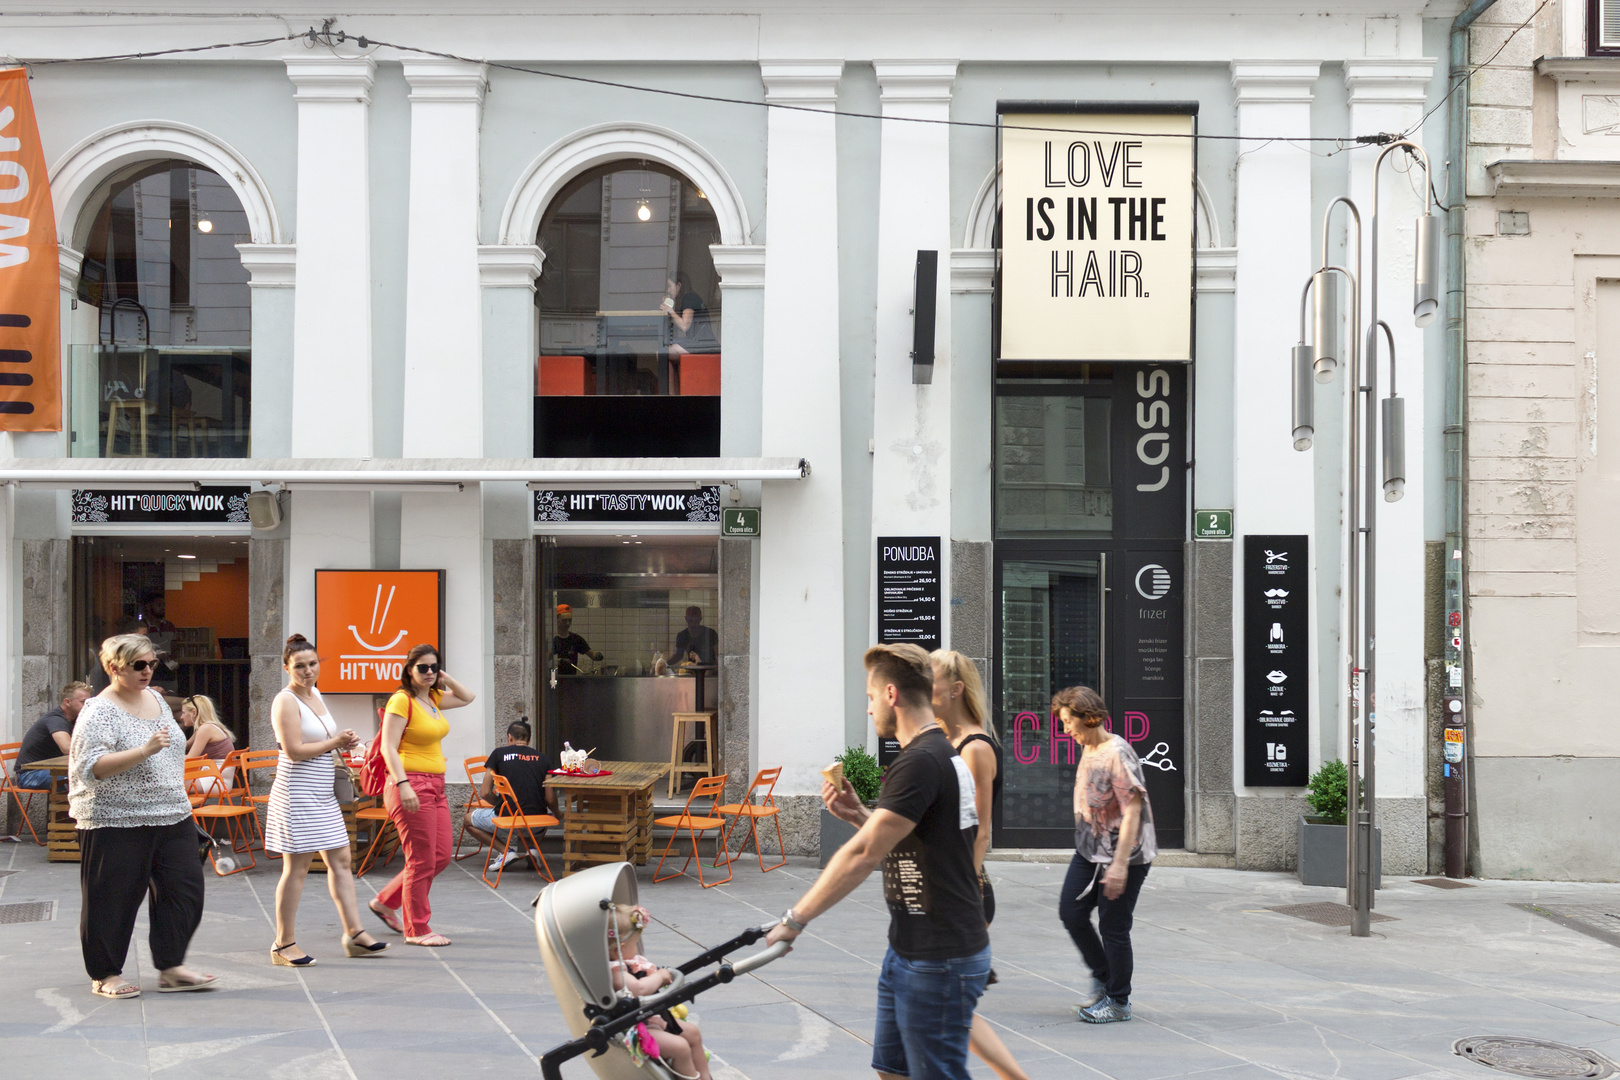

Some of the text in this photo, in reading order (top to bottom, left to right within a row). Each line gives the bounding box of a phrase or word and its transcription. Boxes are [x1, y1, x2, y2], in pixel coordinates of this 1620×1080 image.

[1045, 141, 1142, 188] LOVE
[1026, 197, 1166, 241] IS IN THE
[1051, 250, 1149, 298] HAIR.
[736, 512, 745, 526] 4
[1210, 514, 1218, 528] 2
[883, 546, 935, 561] PONUDBA
[1139, 608, 1167, 618] frizer
[340, 662, 404, 680] HIT'WO
[1014, 711, 1150, 764] CHP
[504, 753, 539, 761] HIT'TASTY
